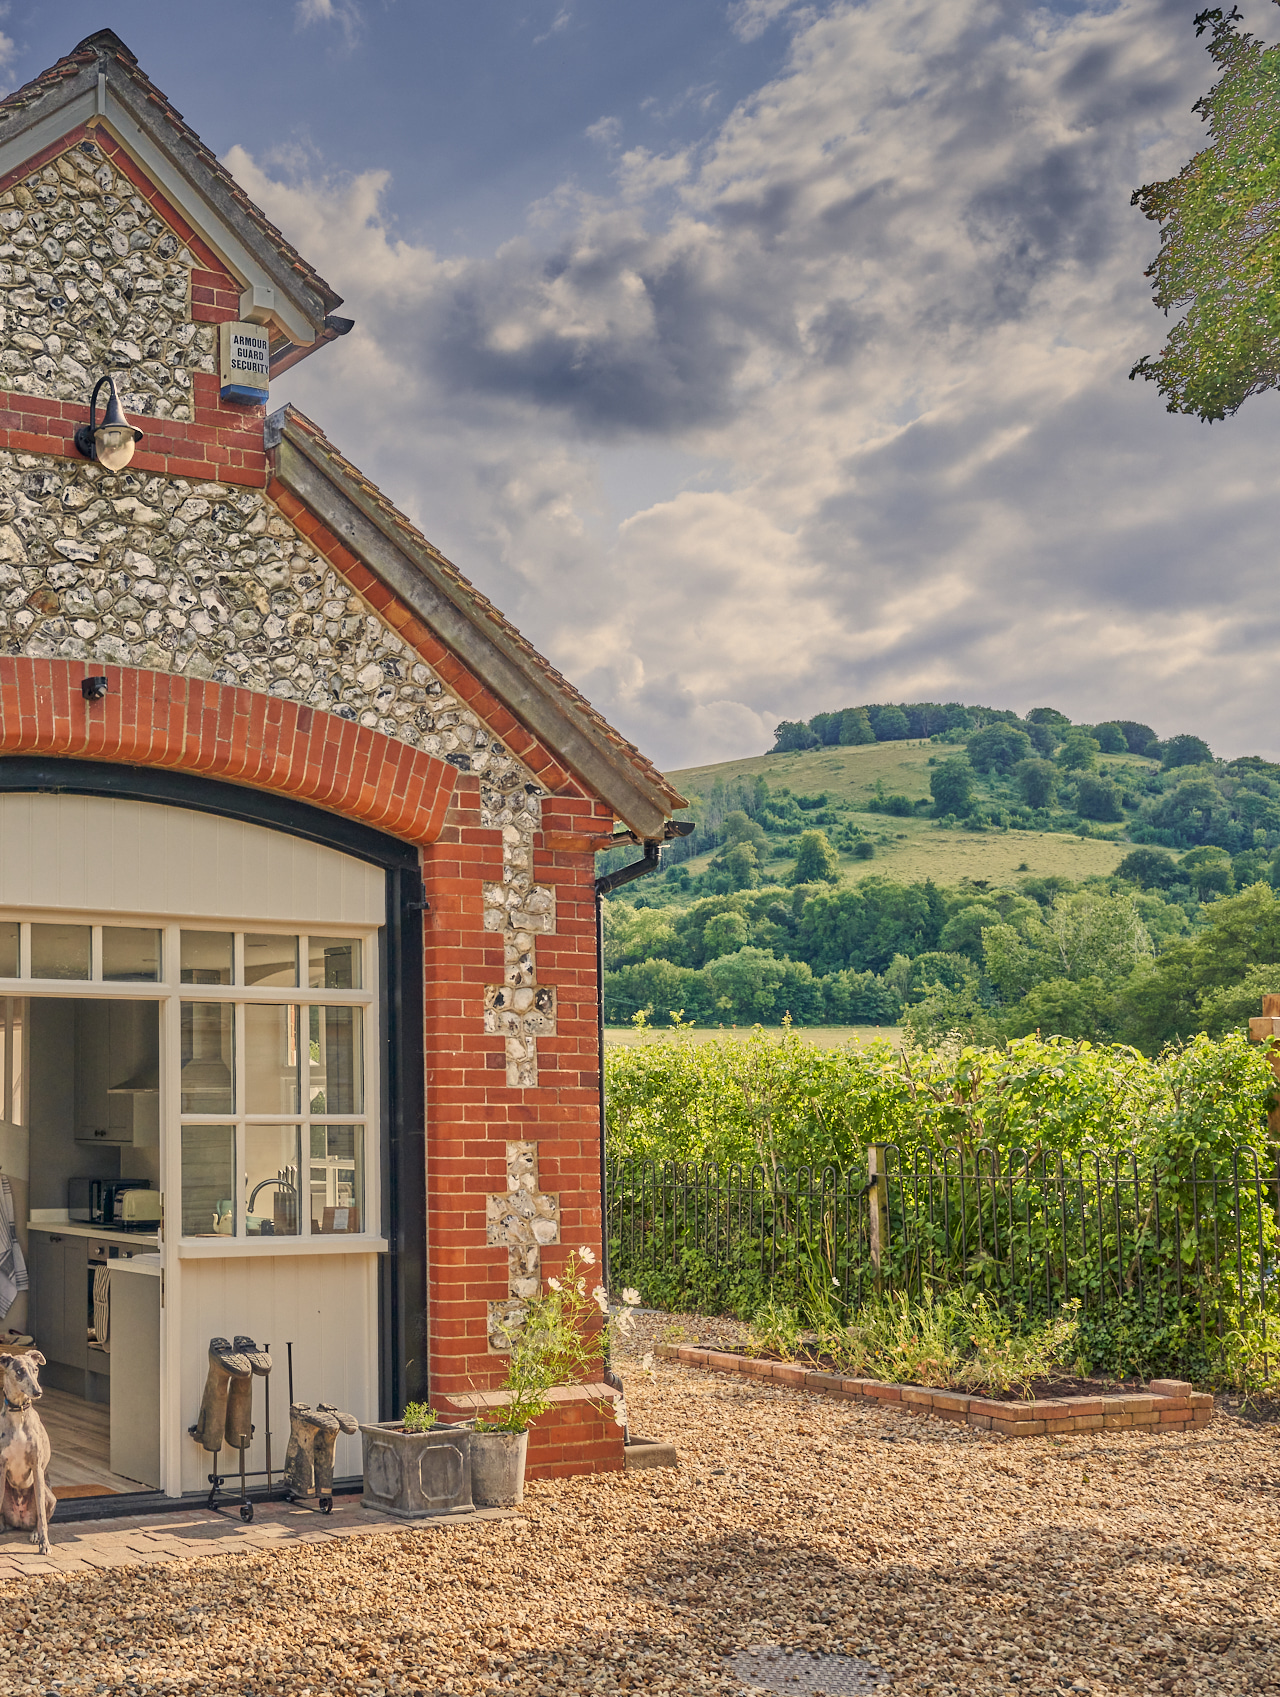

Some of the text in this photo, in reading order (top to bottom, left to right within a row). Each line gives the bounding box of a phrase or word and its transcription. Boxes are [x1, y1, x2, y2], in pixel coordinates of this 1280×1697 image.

[233, 335, 267, 350] ARMOUR
[237, 347, 264, 361] GUARD
[231, 358, 268, 375] SECURITY
